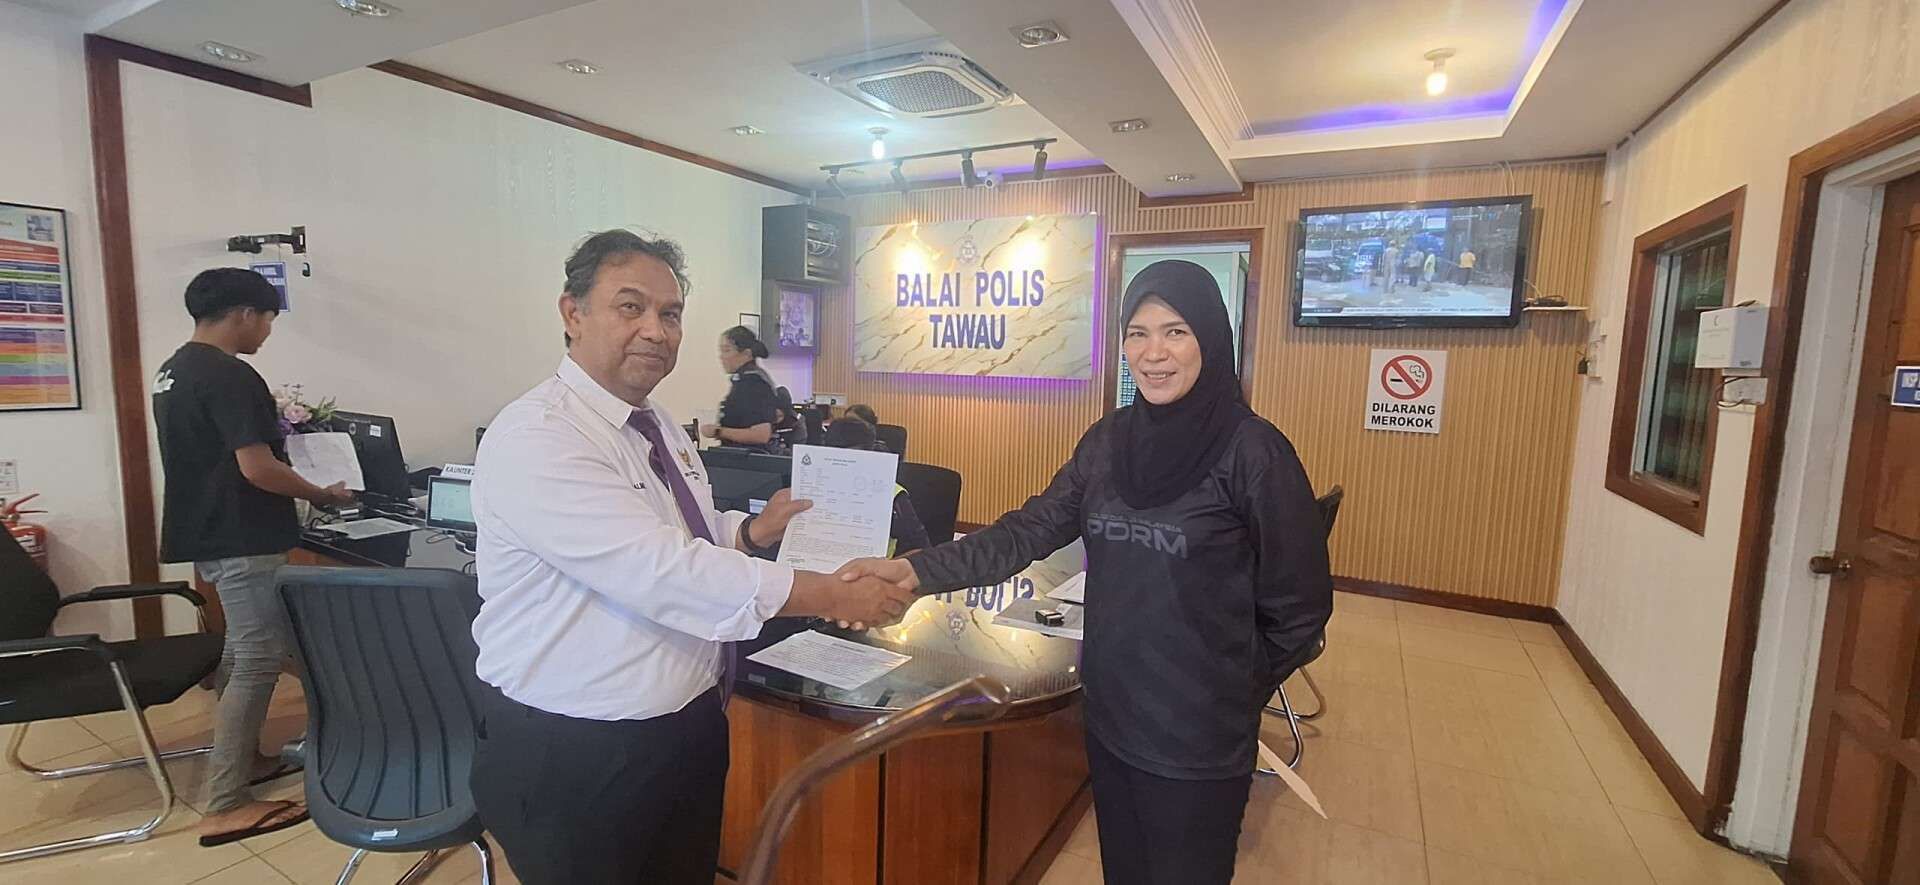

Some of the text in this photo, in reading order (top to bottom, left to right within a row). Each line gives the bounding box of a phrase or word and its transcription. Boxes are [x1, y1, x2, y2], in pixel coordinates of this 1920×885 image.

[897, 270, 1045, 307] BALAI POLIS
[929, 314, 1006, 350] TAWAU
[1372, 403, 1436, 415] DILARANG
[1371, 415, 1434, 429] MEROKOK
[446, 466, 471, 475] KAUNTER
[1087, 518, 1187, 560] PDRM
